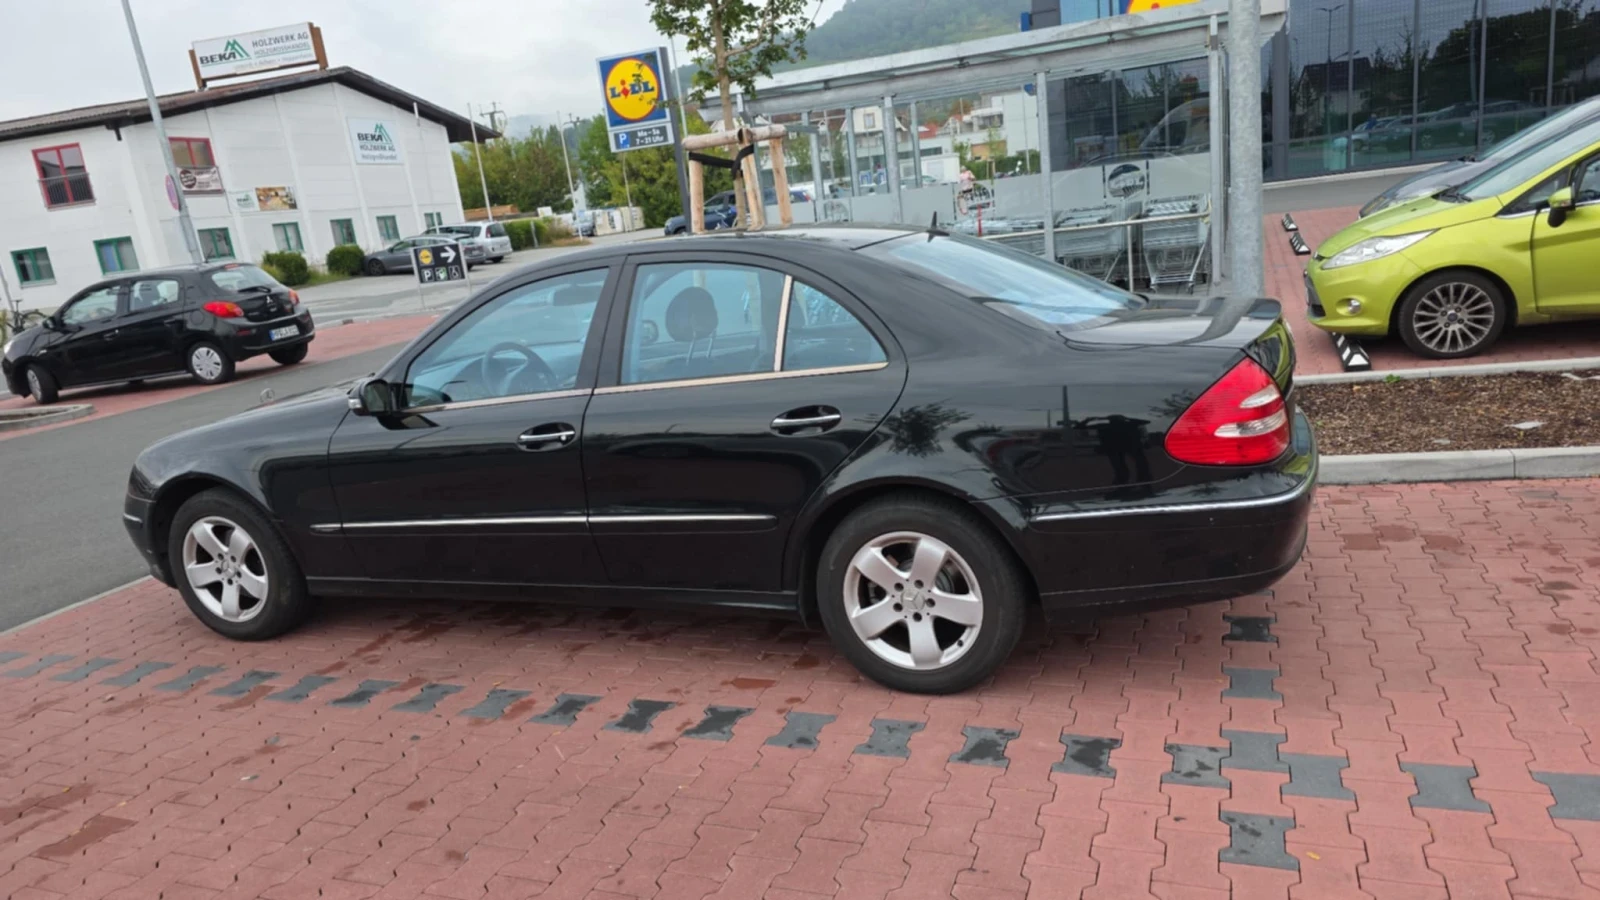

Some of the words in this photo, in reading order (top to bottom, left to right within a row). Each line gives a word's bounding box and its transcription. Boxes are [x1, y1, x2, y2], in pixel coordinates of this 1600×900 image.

[252, 35, 294, 47] HOLZWERK
[297, 31, 309, 40] AG
[200, 52, 236, 64] BEKA
[357, 133, 383, 141] BEKA
[619, 133, 627, 144] P
